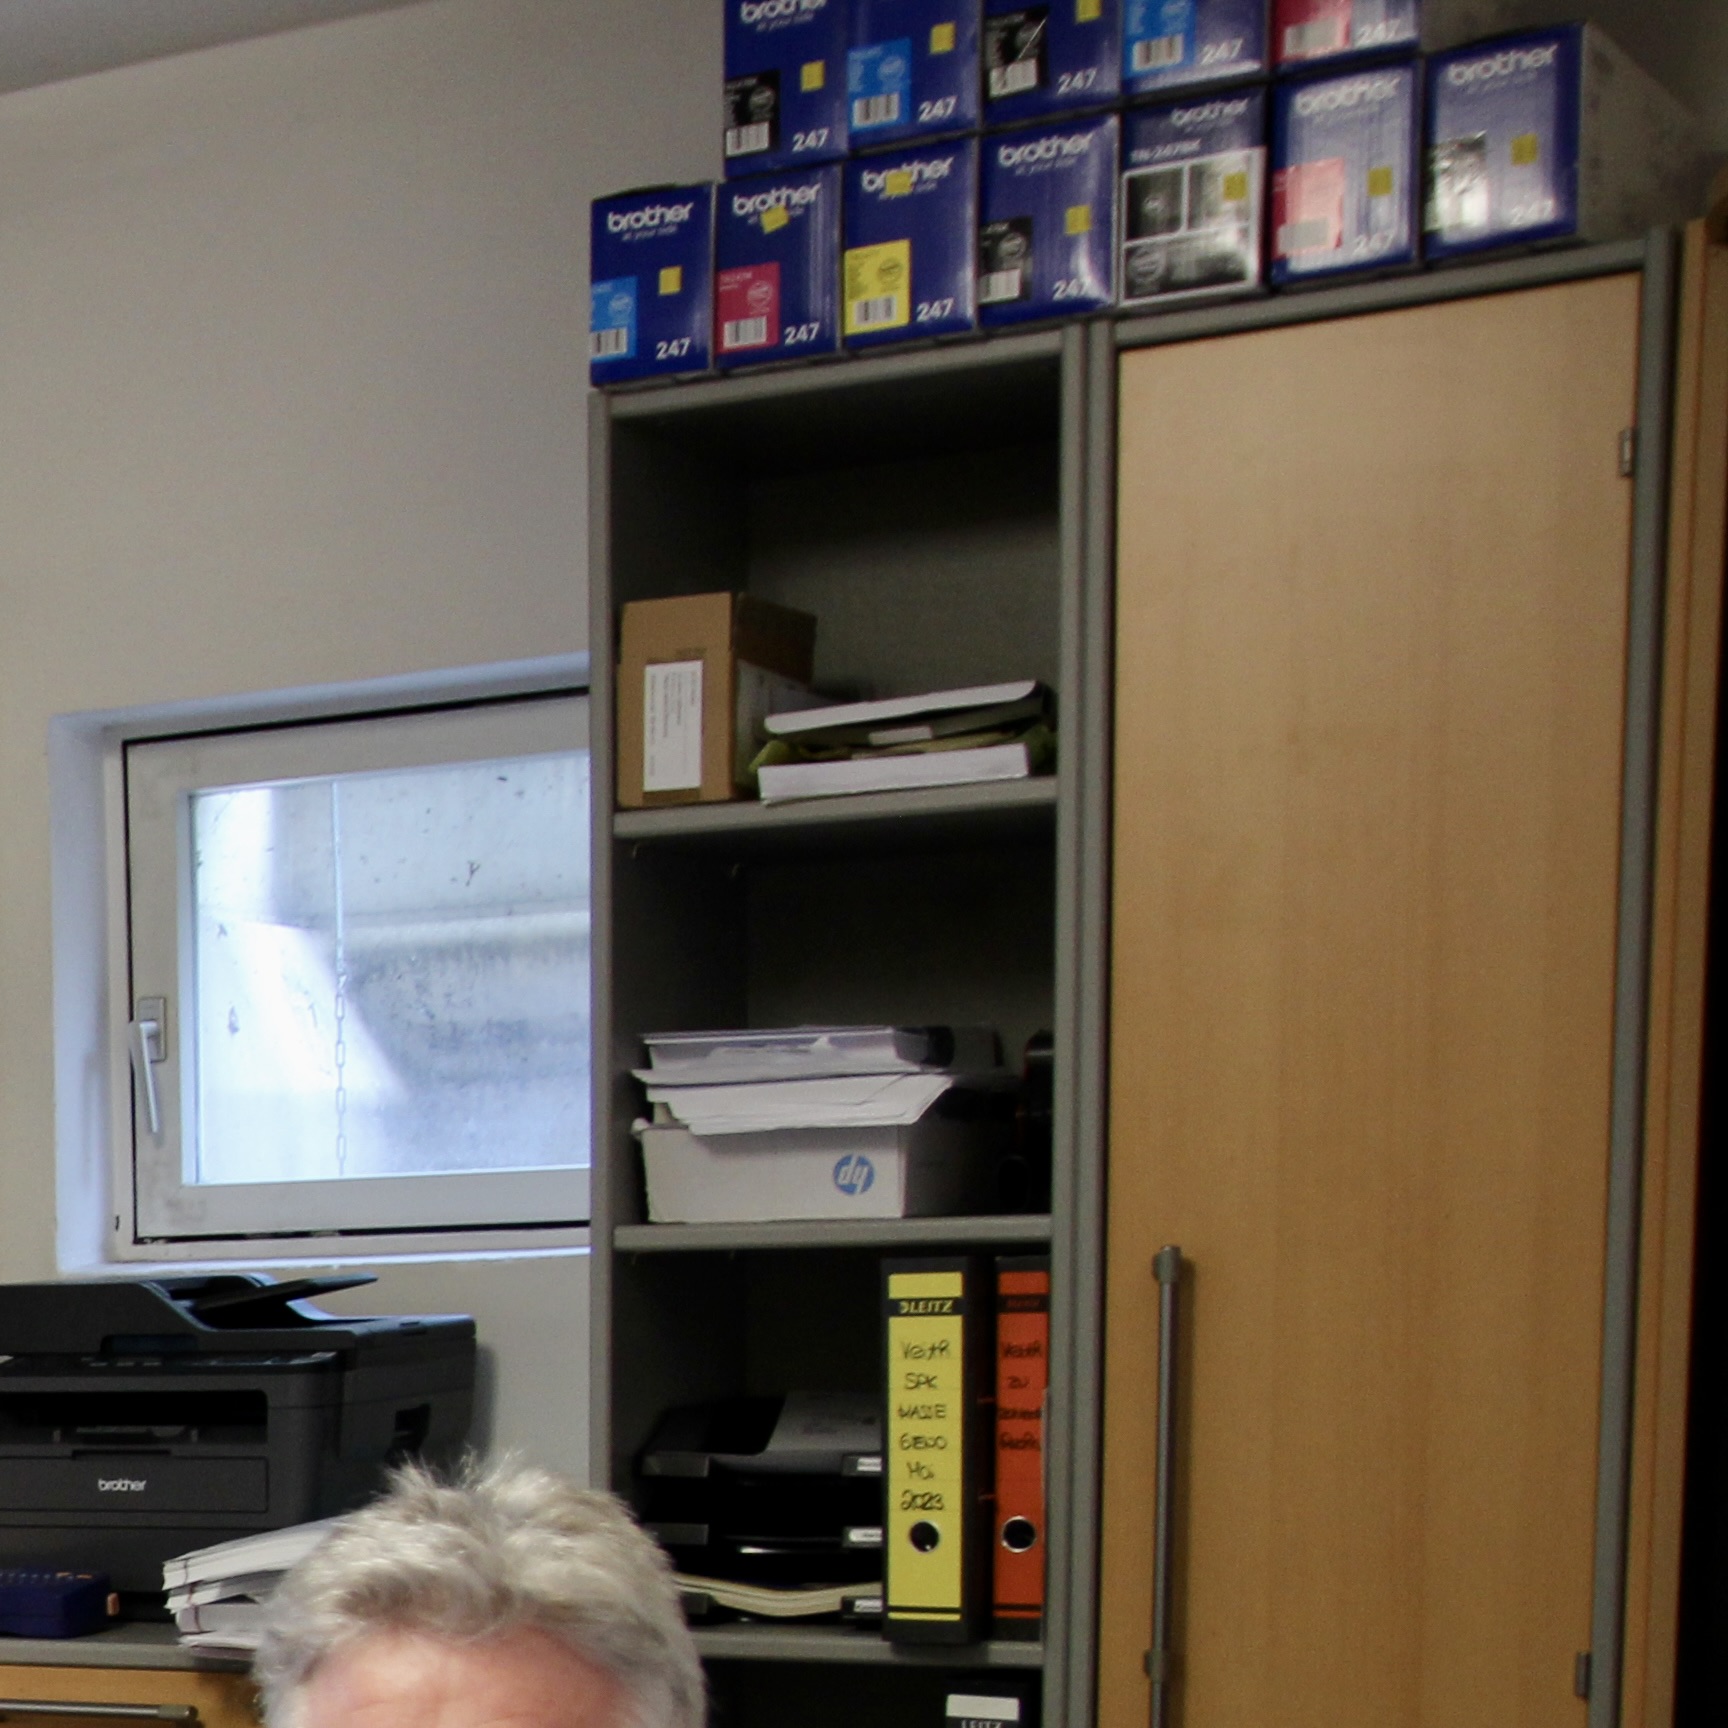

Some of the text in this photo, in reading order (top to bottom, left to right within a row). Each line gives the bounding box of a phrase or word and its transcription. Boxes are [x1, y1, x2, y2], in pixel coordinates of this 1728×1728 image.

[1200, 37, 1243, 66] 247
[1448, 43, 1559, 86] brother
[1057, 67, 1097, 96] 247
[918, 96, 958, 123] 247
[1296, 75, 1401, 117] brother
[1171, 101, 1248, 128] brother
[792, 128, 830, 153] 247
[998, 131, 1094, 169] brother
[607, 201, 694, 235] brother
[917, 298, 955, 323] 247
[784, 321, 821, 346] 247
[655, 336, 691, 361] 247
[836, 1153, 872, 1196] hp
[909, 1299, 954, 1315] LEITZ
[97, 1478, 147, 1492] brother
[900, 1489, 945, 1512] 2023
